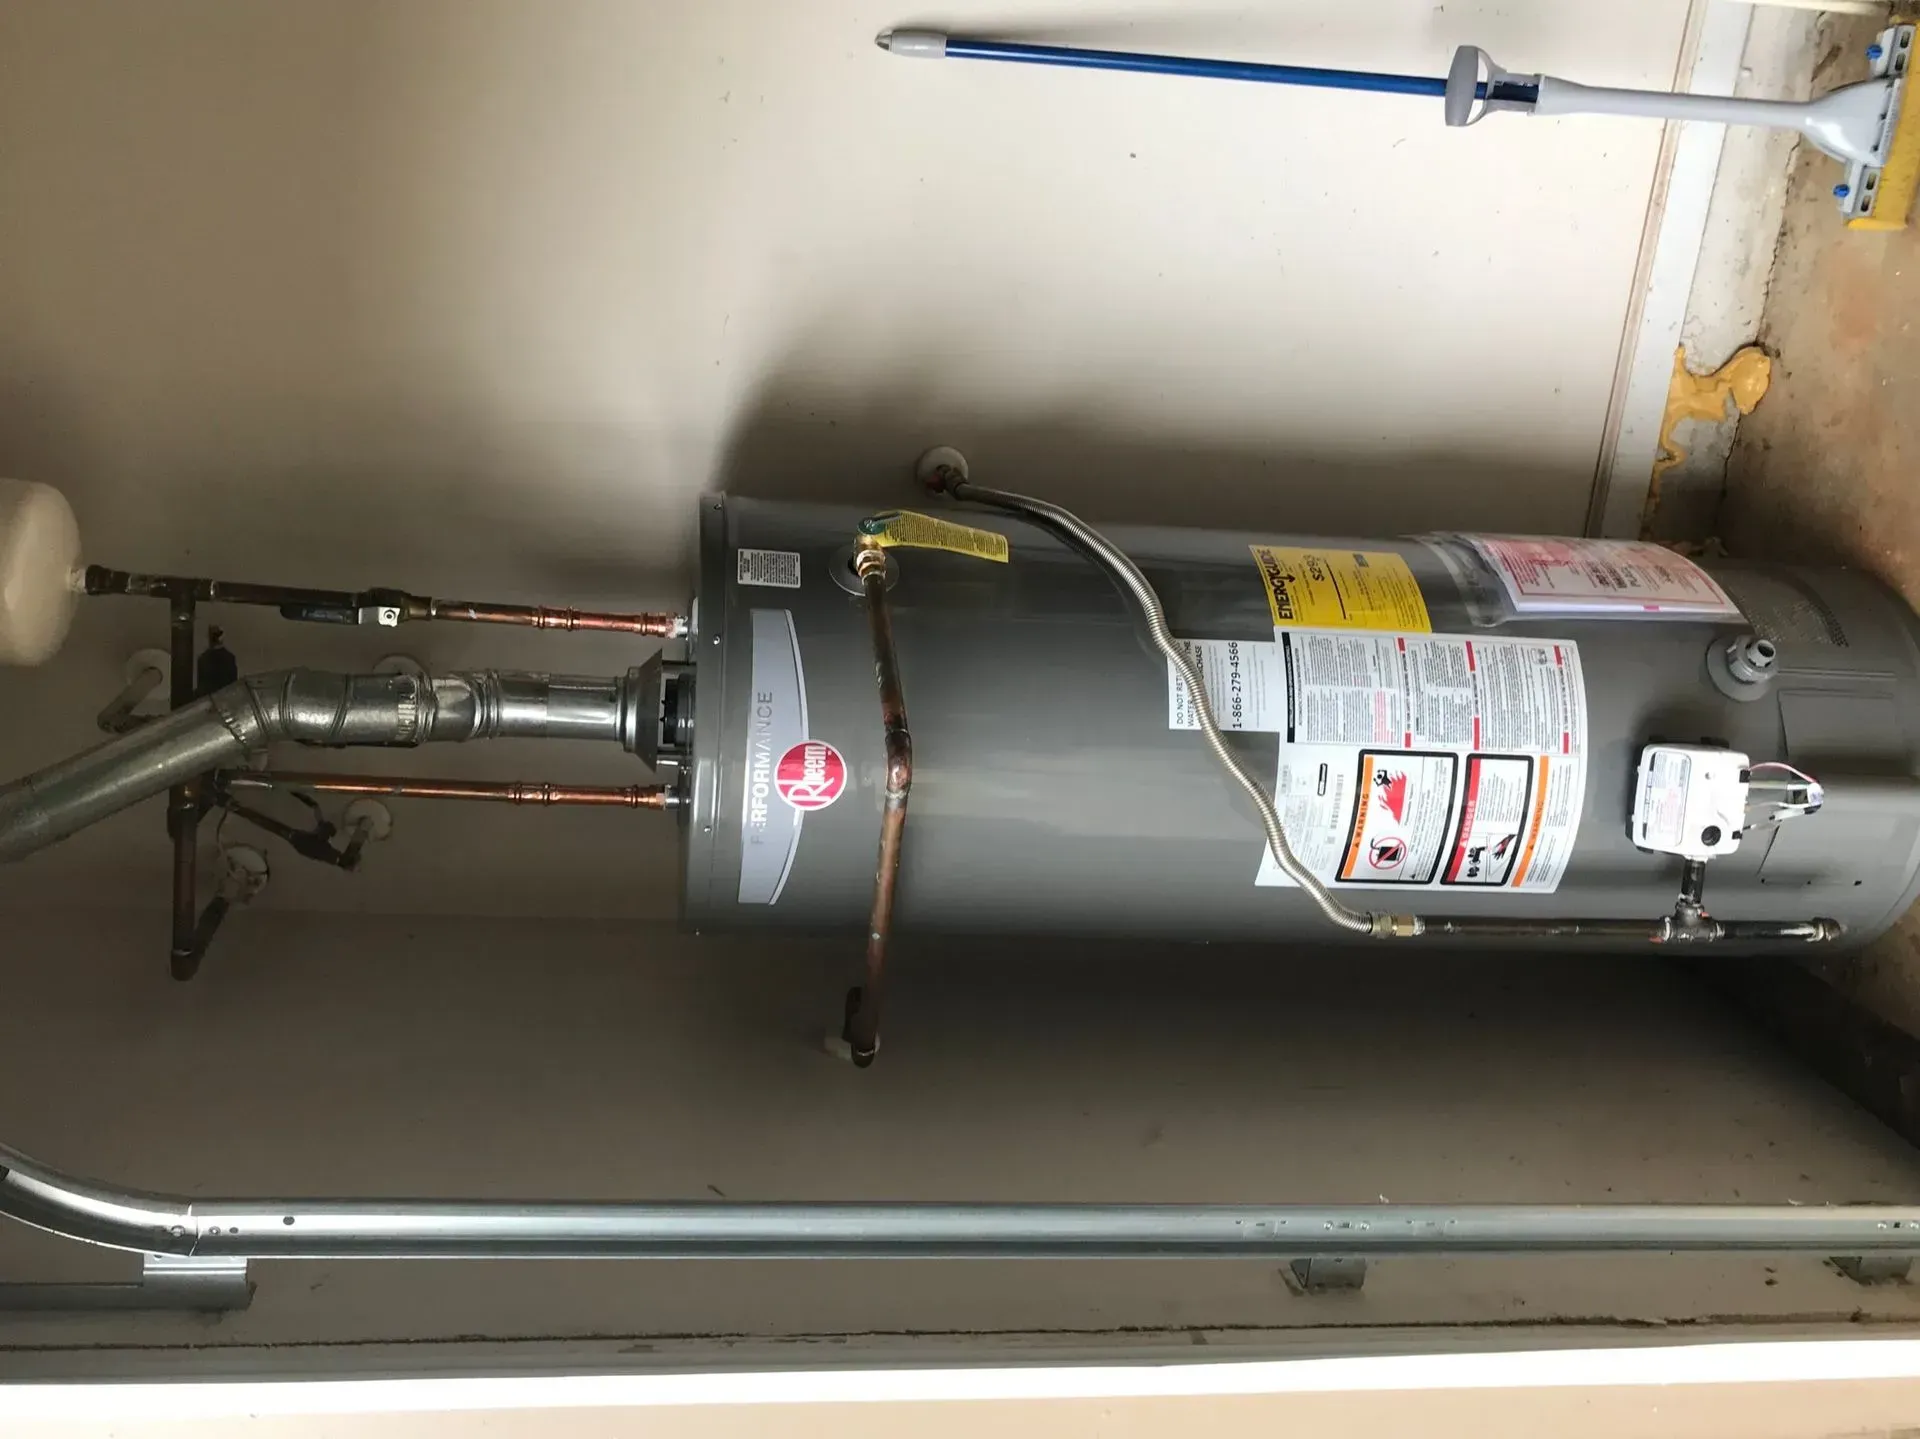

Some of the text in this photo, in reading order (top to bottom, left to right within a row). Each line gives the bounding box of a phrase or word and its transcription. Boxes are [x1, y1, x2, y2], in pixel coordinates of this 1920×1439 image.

[1176, 693, 1184, 710] NOT
[1228, 641, 1242, 729] 1-866-279-4566
[1176, 712, 1184, 725] DO
[1187, 699, 1195, 727] WATER
[750, 691, 773, 846] PERFORMANCE
[775, 745, 835, 804] Rheem
[1354, 793, 1369, 838] WARNING
[1462, 800, 1476, 839] DANGER
[1530, 800, 1544, 841] WARNING
